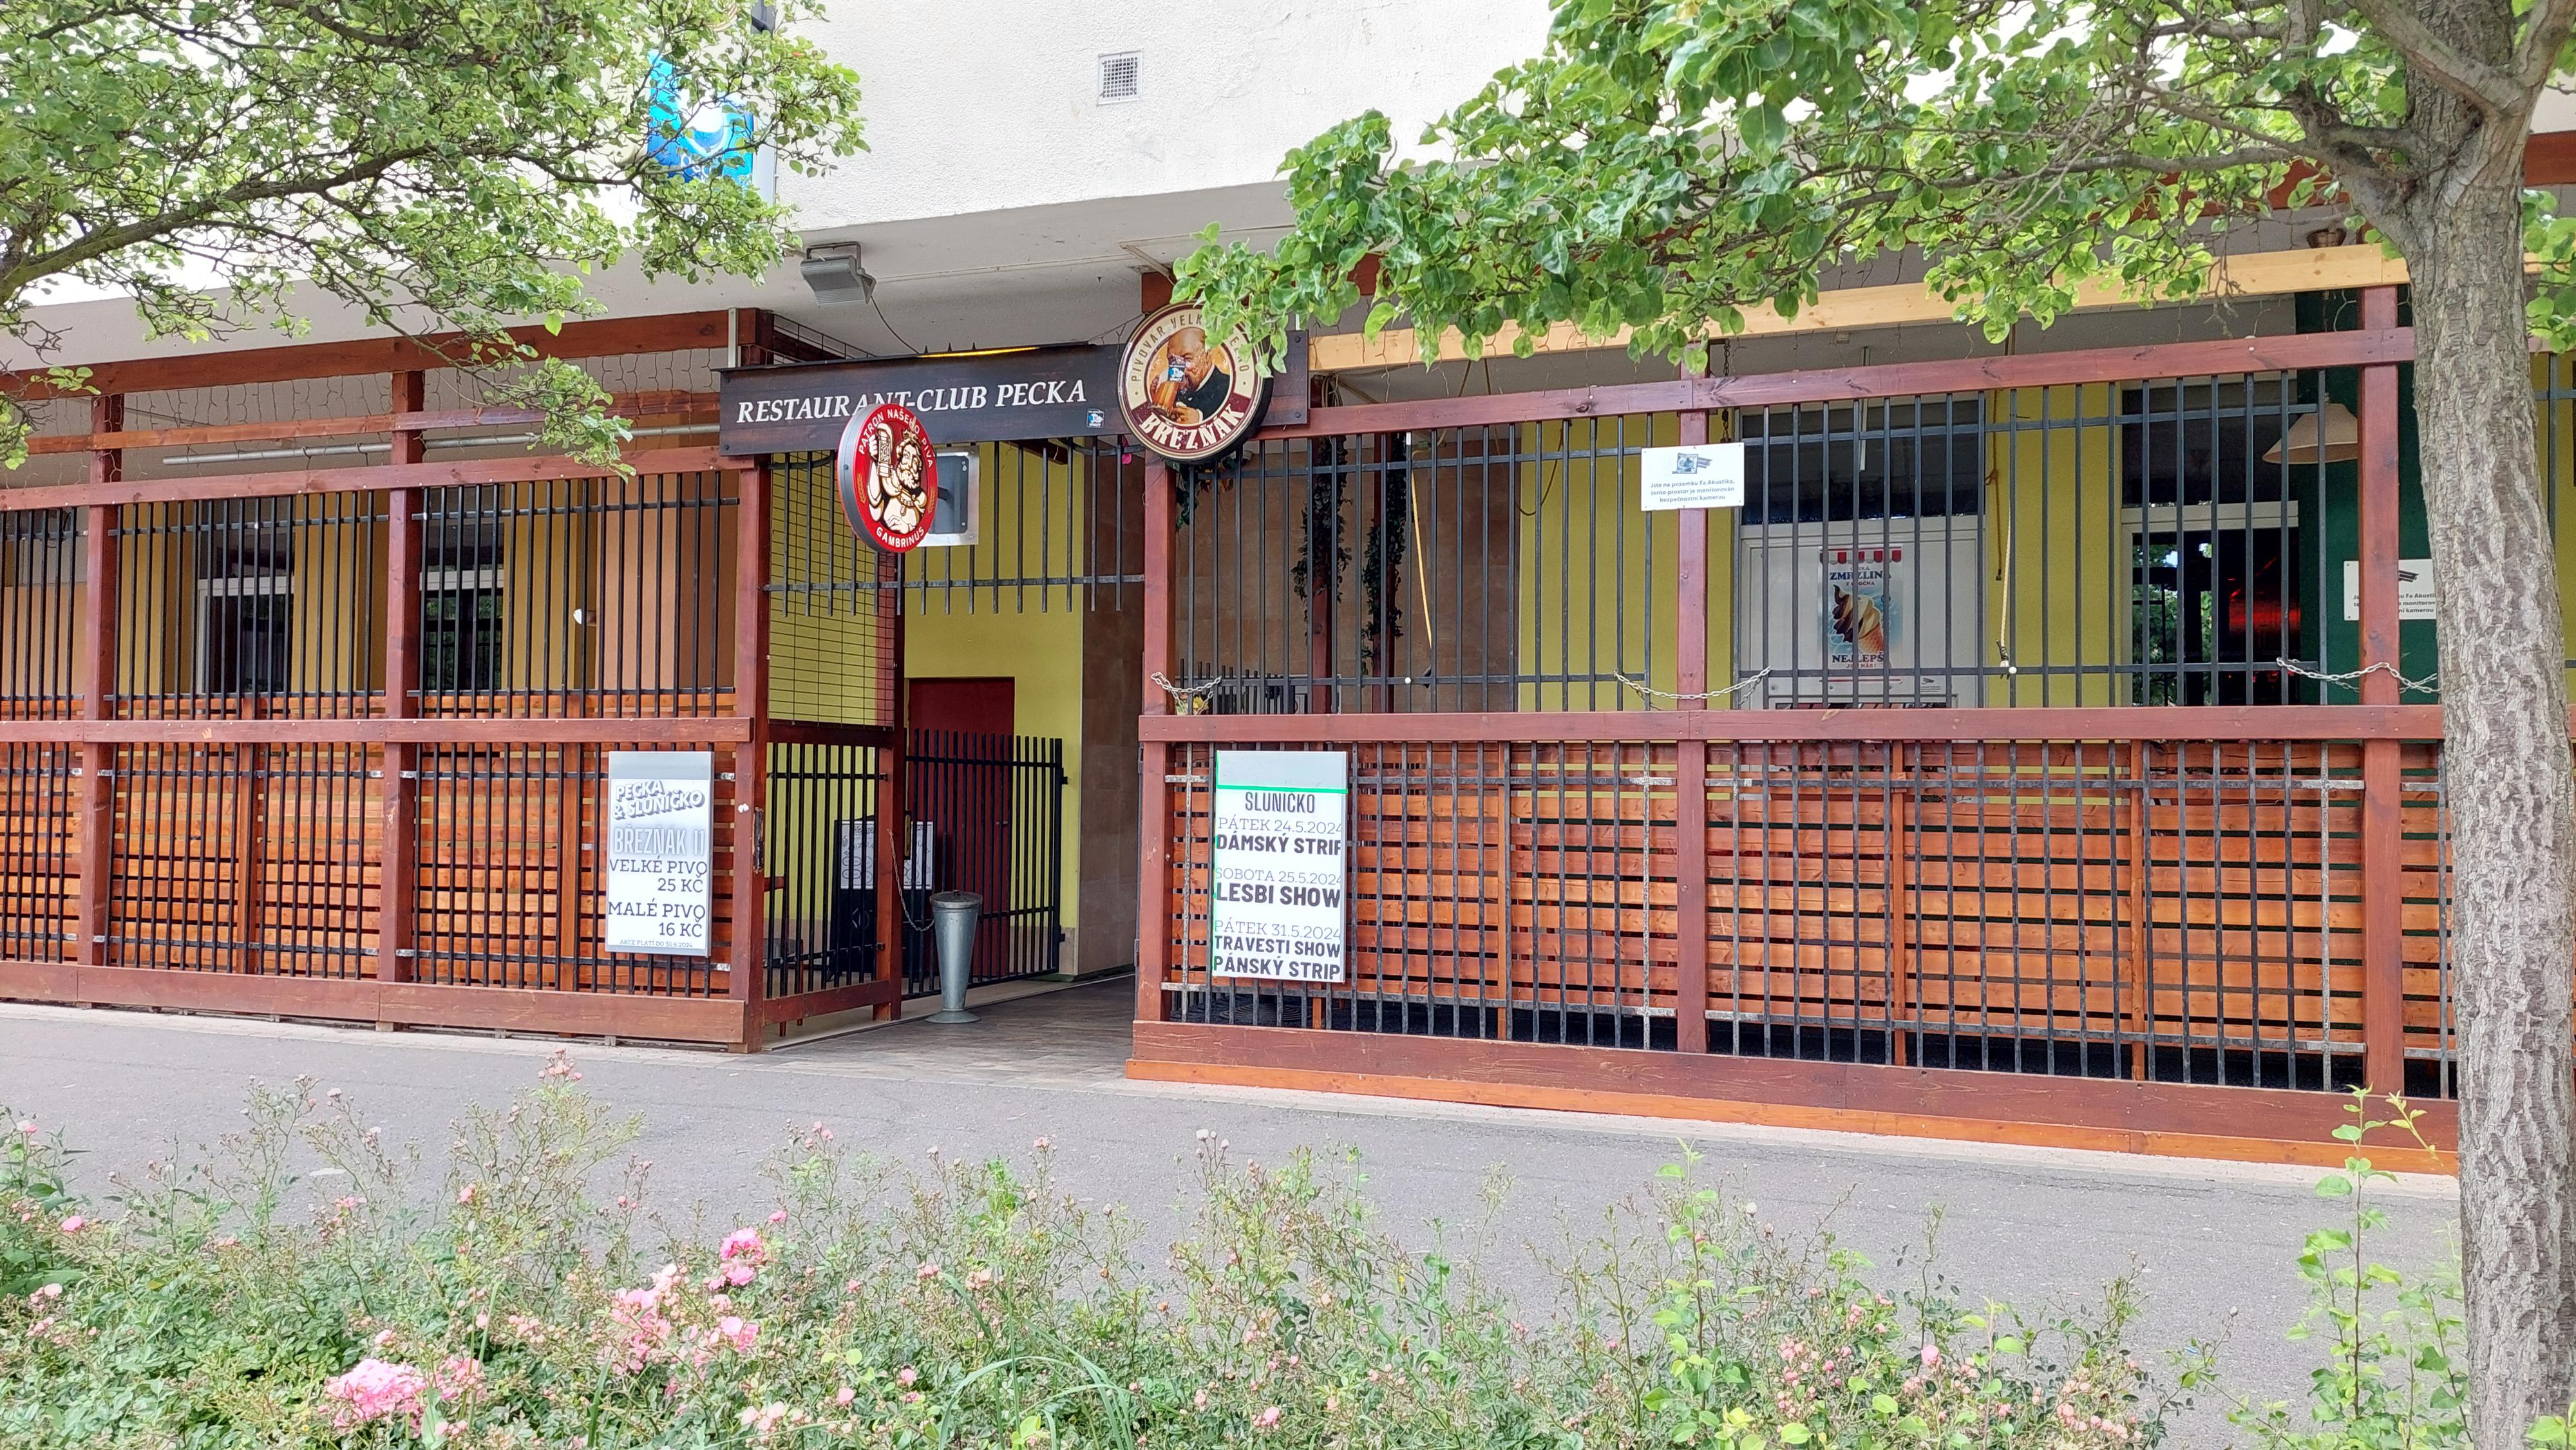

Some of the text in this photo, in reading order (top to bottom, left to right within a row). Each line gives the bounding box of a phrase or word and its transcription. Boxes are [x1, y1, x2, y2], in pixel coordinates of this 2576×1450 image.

[1131, 314, 1202, 381] PIVOVAR VELK
[995, 379, 1087, 407] PECKA
[1139, 404, 1245, 450] BŘEZŇÁK
[858, 412, 884, 455] PATRON
[922, 438, 933, 468] PIVA
[876, 527, 925, 548] GAMBRINUS
[1830, 570, 1892, 580] ZMRZLIN
[1832, 652, 1884, 663] NEJLEPŠ
[616, 779, 665, 802] PECKA
[612, 804, 626, 820] &
[1218, 814, 1271, 831] PÁTEK
[614, 824, 705, 856] BŘEZŇÁK 11
[1217, 831, 1289, 852] DÁMSKÝ
[609, 855, 708, 875] VELKÉ PIVO
[1215, 867, 1275, 881] SOBOTA
[658, 874, 703, 893] 25 KČ
[1217, 882, 1340, 908] LESBI SHOW
[608, 898, 706, 919] MALÉ PIVO
[659, 919, 702, 937] 16 KČ
[1214, 917, 1267, 935] PÁTEK
[1215, 935, 1340, 958] TRAVESTI SHOW
[1214, 952, 1340, 980] PÁNSKÝ STRIP
